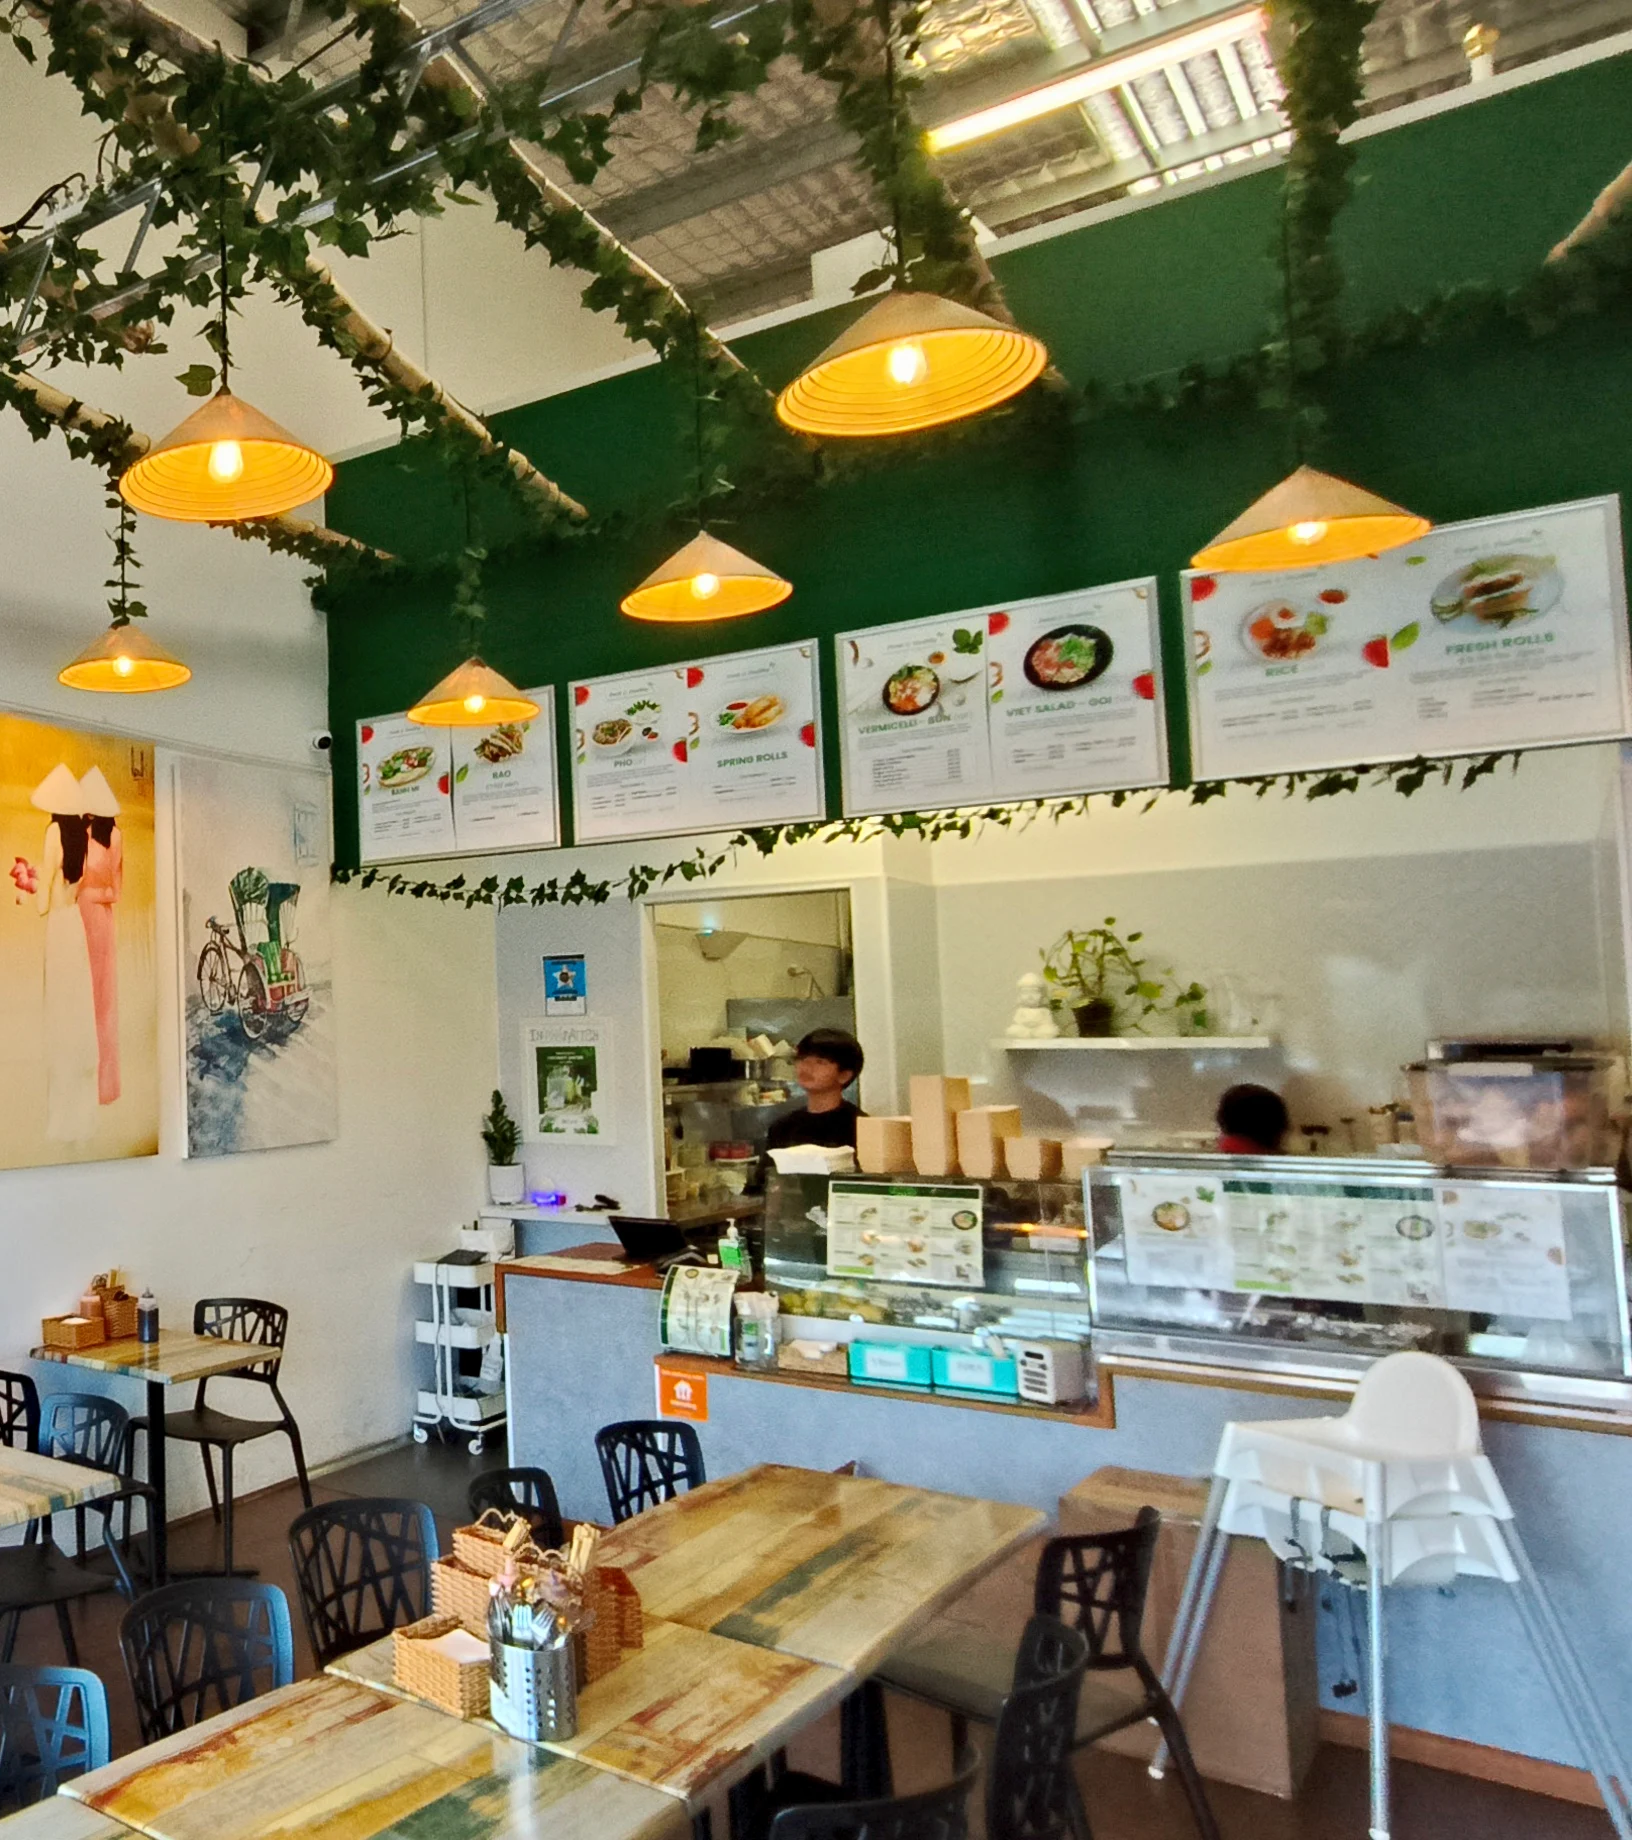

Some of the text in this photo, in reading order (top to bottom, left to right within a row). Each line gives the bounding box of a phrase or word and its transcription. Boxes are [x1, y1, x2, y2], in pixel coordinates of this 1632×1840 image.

[1035, 700, 1076, 714] SALAD
[717, 751, 788, 768] SPRING ROLLS
